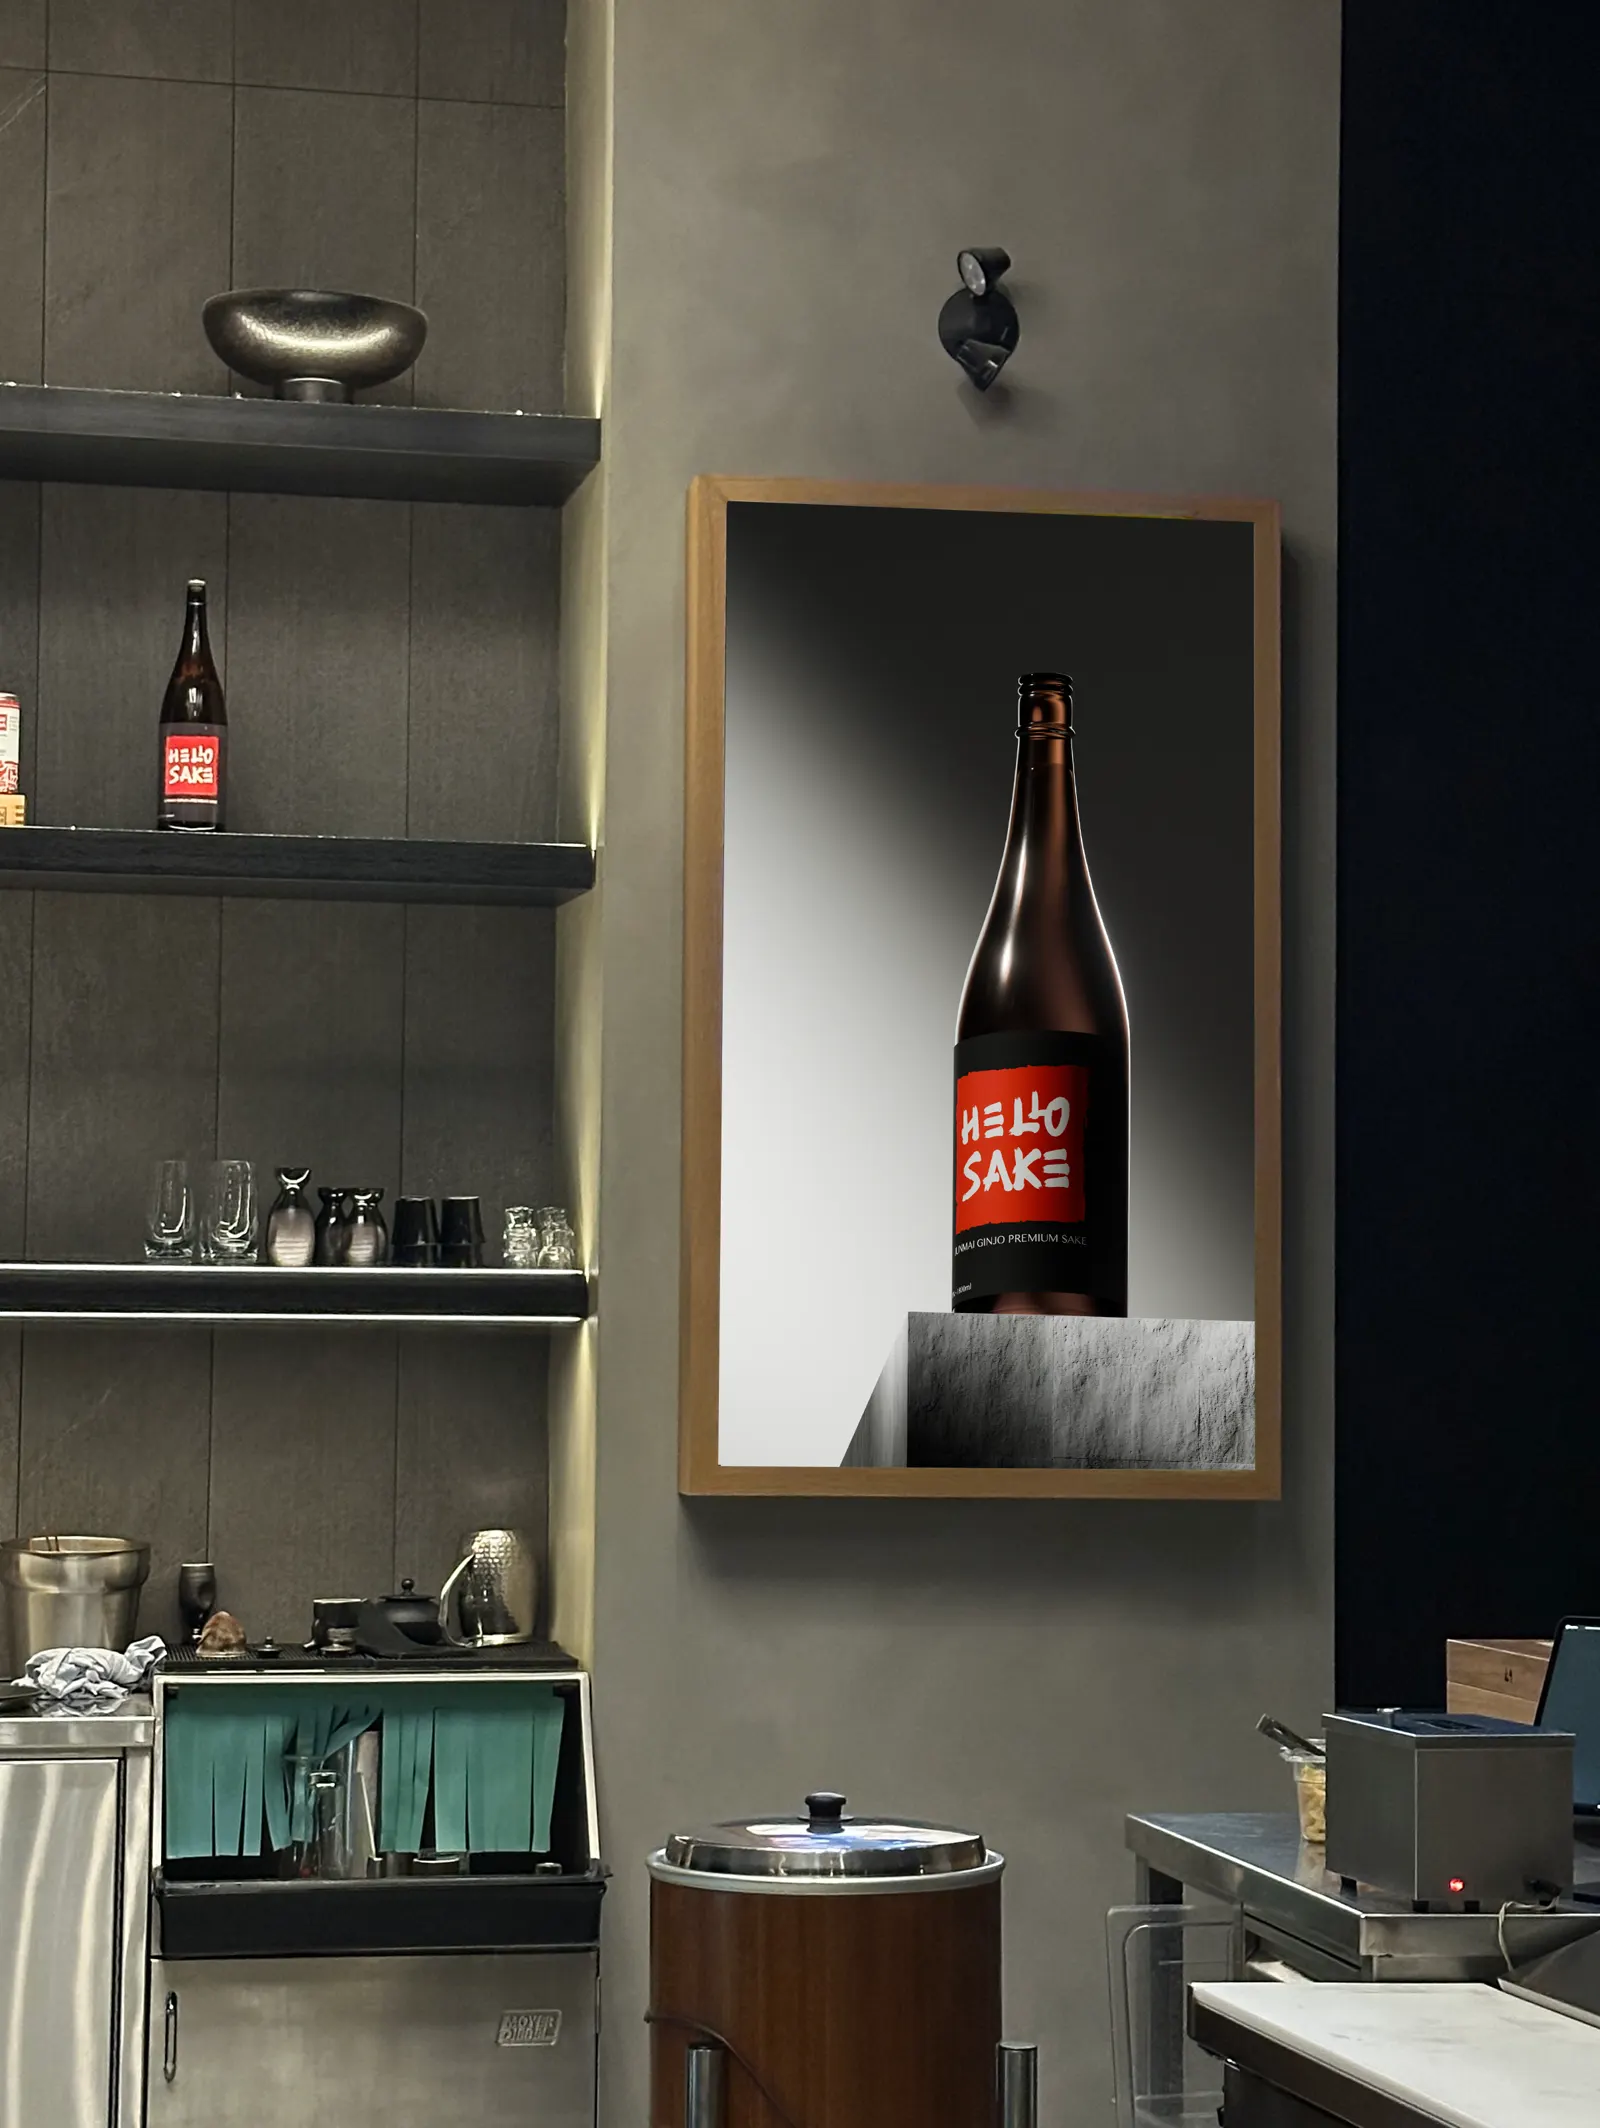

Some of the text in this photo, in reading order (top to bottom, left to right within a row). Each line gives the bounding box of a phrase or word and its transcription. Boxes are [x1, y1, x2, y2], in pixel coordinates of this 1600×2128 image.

[168, 745, 213, 765] HELLO
[168, 765, 213, 784] SAKE
[961, 1090, 1070, 1145] HELLO
[962, 1147, 1070, 1202] SAKE
[976, 1235, 1006, 1248] GINJO
[1008, 1233, 1059, 1244] PREMIUM
[1061, 1234, 1088, 1246] SAKE
